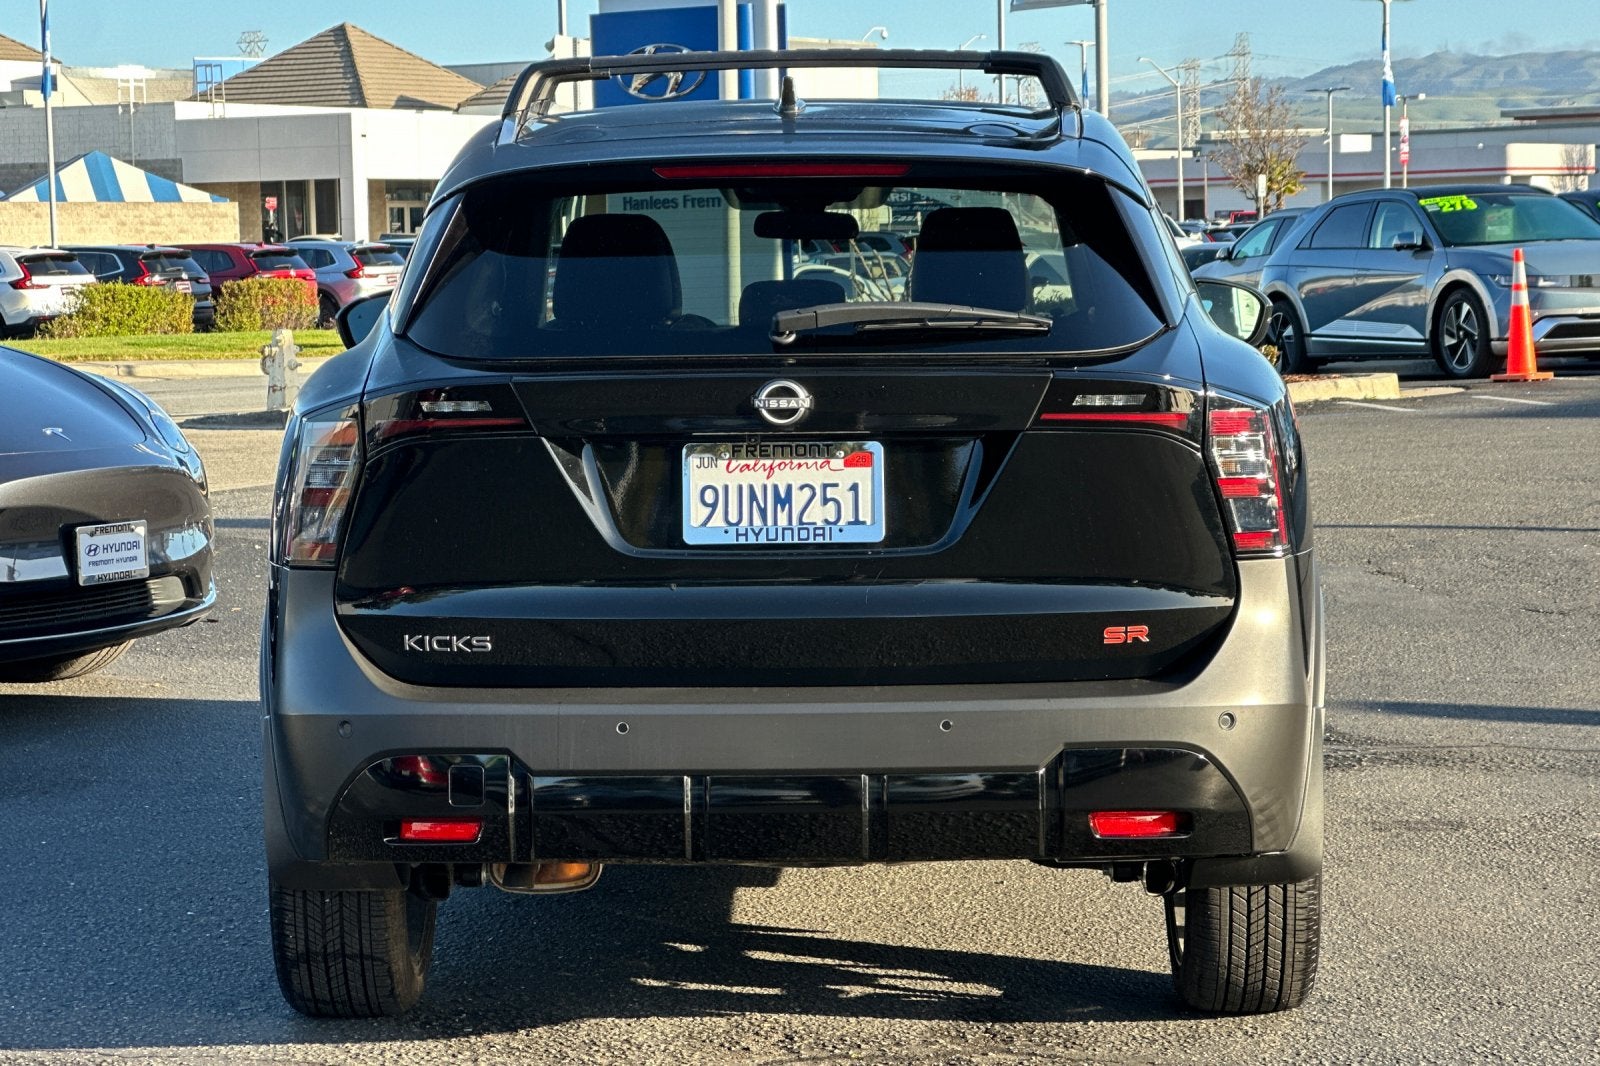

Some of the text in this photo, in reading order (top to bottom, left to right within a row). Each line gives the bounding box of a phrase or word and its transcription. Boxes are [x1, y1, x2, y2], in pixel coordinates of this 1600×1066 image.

[622, 195, 680, 211] Hanlees
[755, 399, 810, 408] NISSAN
[732, 442, 834, 458] FREMONT
[696, 456, 718, 469] JUN
[725, 459, 845, 480] California
[700, 482, 867, 527] 9UNM251
[94, 523, 131, 535] FREMONT
[735, 527, 833, 542] HYUNDAI
[102, 540, 141, 554] HYUNDAI
[88, 555, 138, 567] FREMONT HYUNDAI
[97, 570, 132, 582] HYUNDAI
[1103, 625, 1150, 644] SR
[403, 634, 492, 652] KICKS
